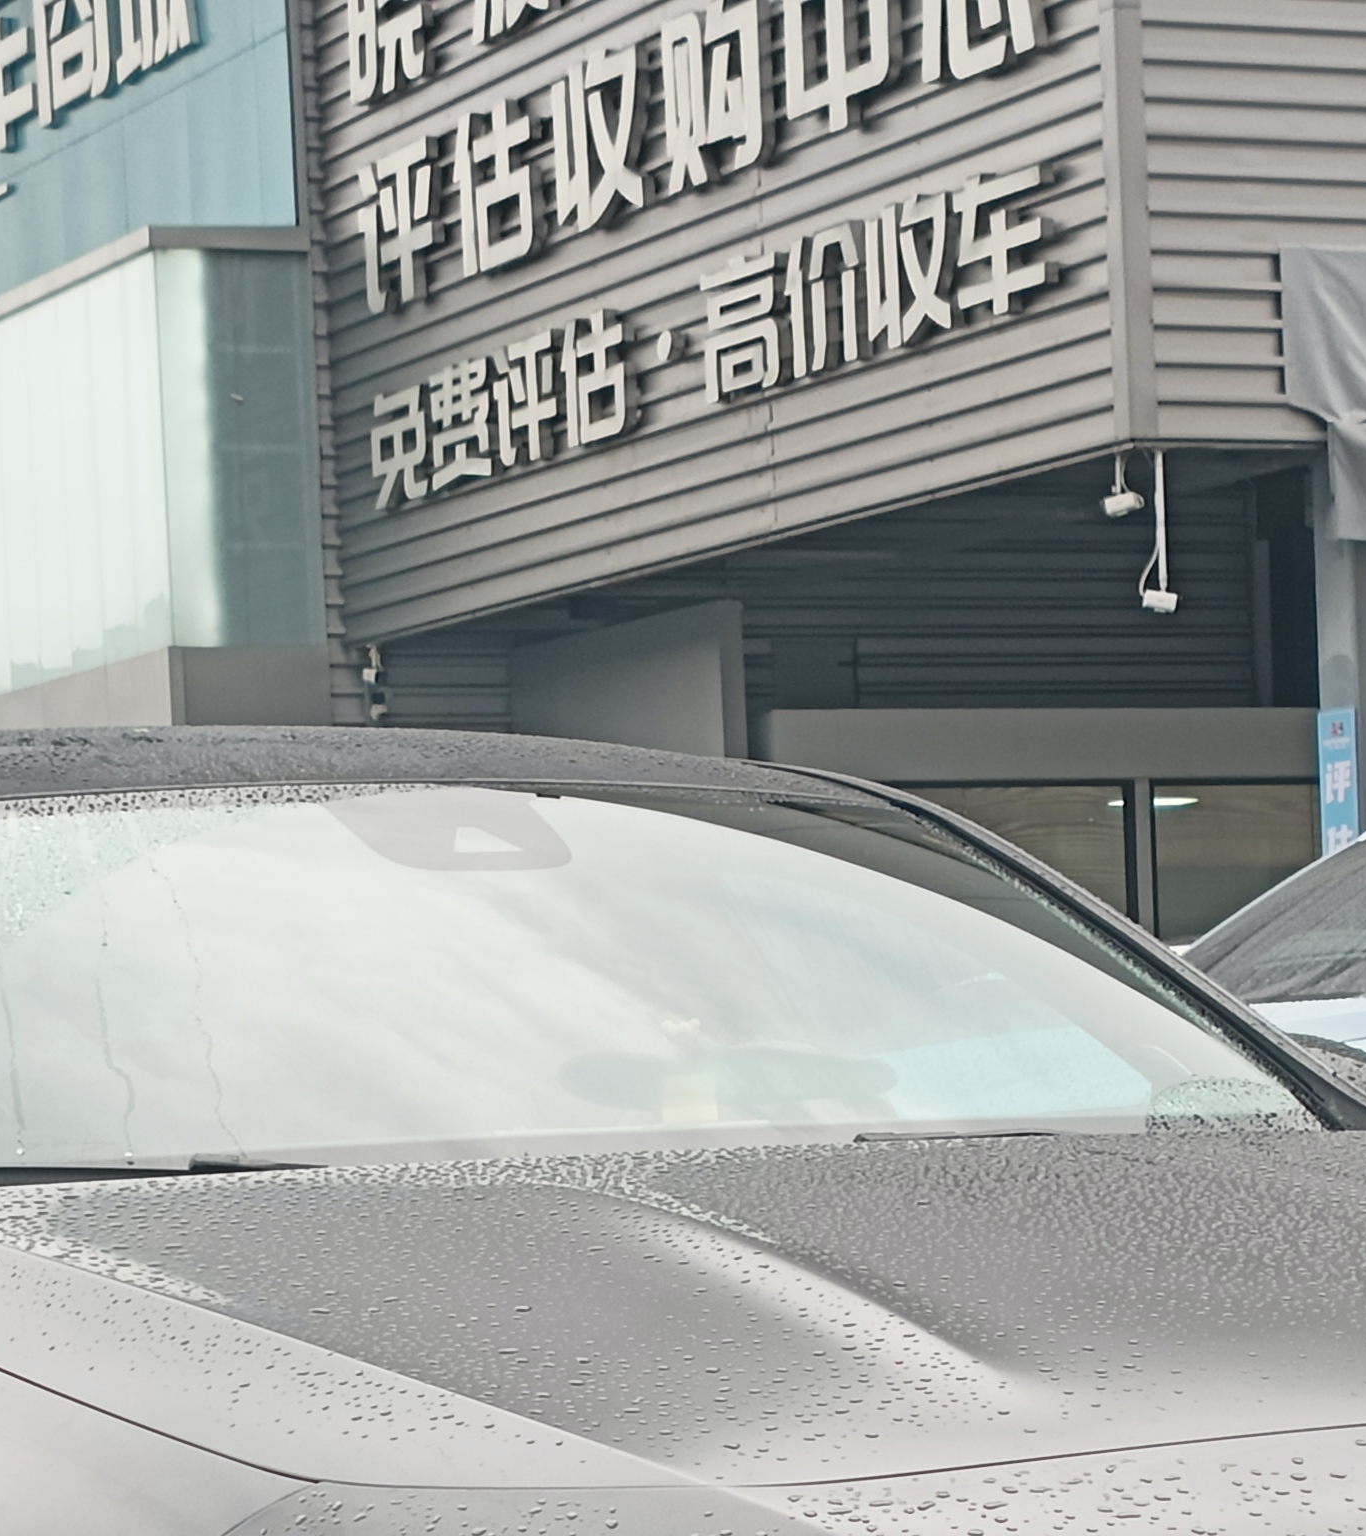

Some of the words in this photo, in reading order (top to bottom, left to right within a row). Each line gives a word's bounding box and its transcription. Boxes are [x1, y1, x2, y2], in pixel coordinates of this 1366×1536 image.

[370, 165, 1043, 510] 免费评估·高价收车
